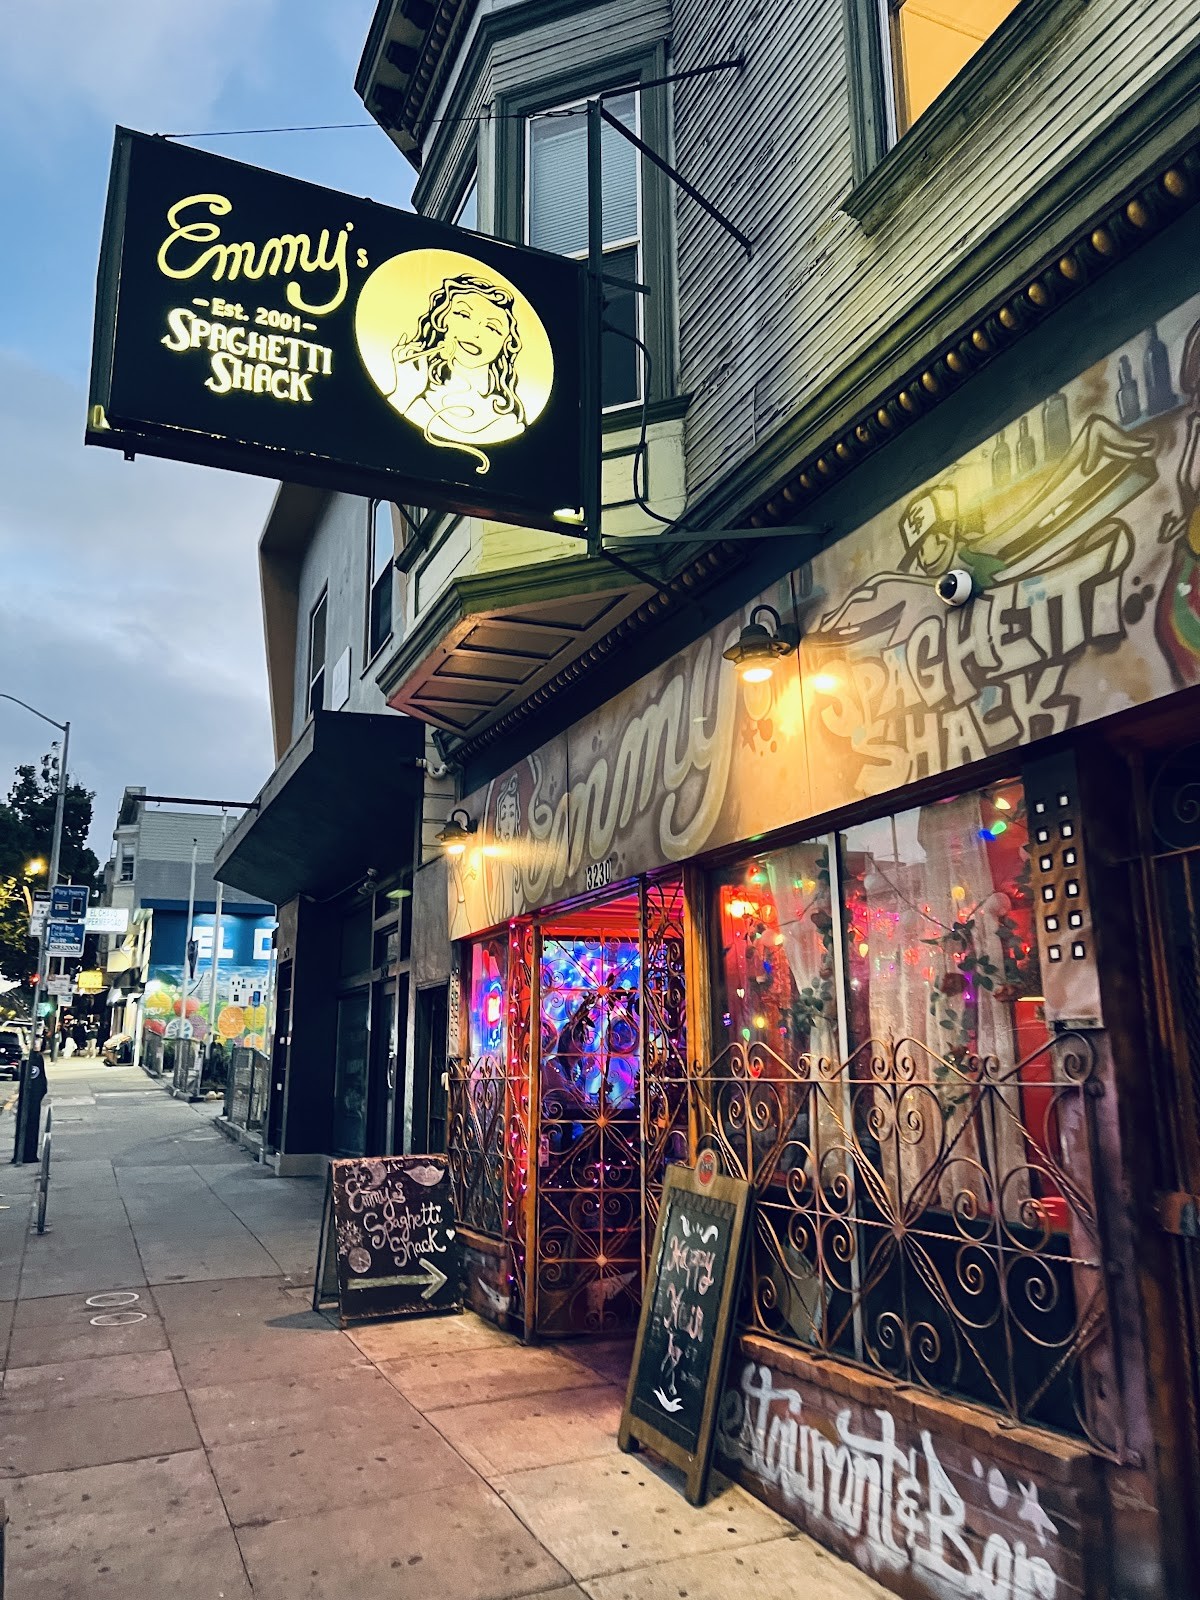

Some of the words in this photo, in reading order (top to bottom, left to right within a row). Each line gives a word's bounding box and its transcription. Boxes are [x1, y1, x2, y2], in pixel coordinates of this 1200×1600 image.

[157, 193, 368, 315] Emmy's
[160, 307, 333, 375] SPAGHETTI
[204, 351, 313, 402] SHACK
[853, 663, 1070, 793] SHACK
[54, 888, 67, 897] Pay
[69, 889, 86, 897] here
[586, 858, 612, 890] 3230
[51, 924, 63, 932] Pay
[65, 924, 74, 932] by
[192, 926, 234, 959] EL
[344, 1178, 406, 1220] Emmy's
[363, 1202, 443, 1249] Spaghetti
